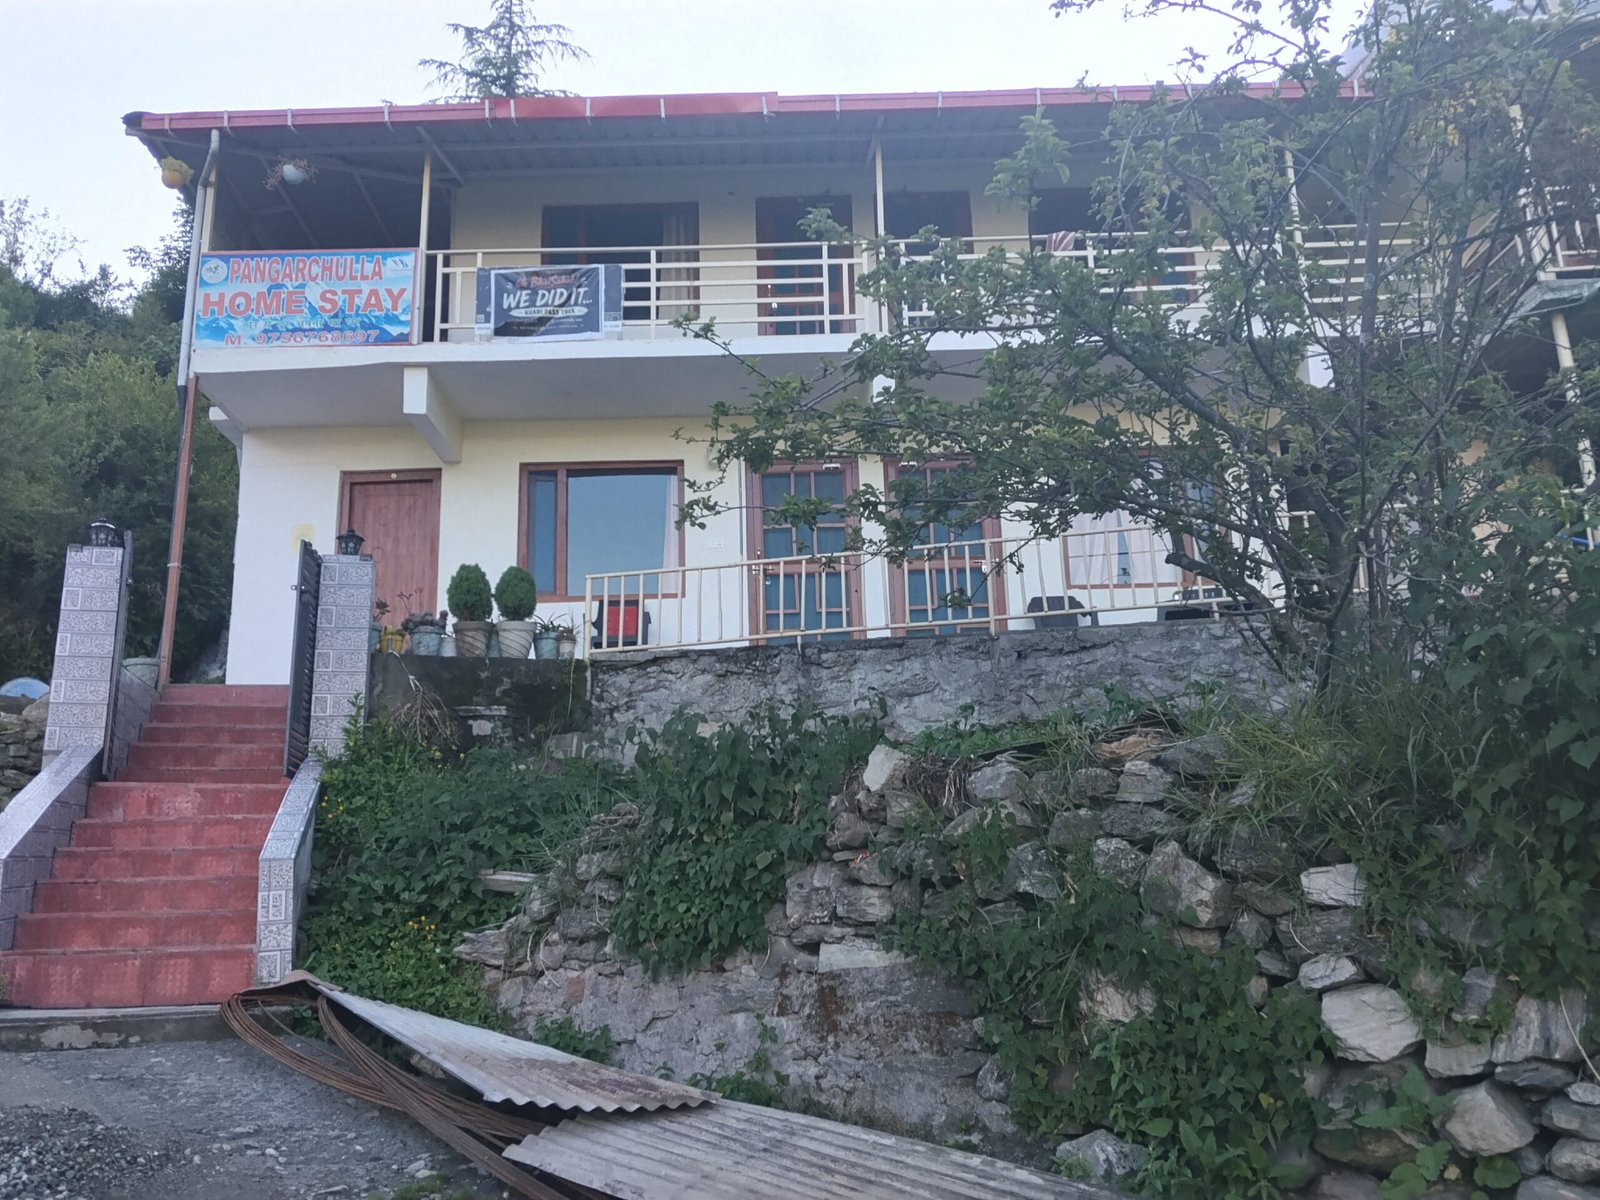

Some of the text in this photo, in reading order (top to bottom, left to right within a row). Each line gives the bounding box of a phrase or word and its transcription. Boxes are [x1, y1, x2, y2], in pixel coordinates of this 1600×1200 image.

[229, 256, 383, 284] PANGARCHULLA
[201, 287, 408, 317] HOME STAY
[502, 290, 532, 309] WE
[536, 288, 567, 306] DID
[225, 334, 247, 346] M.
